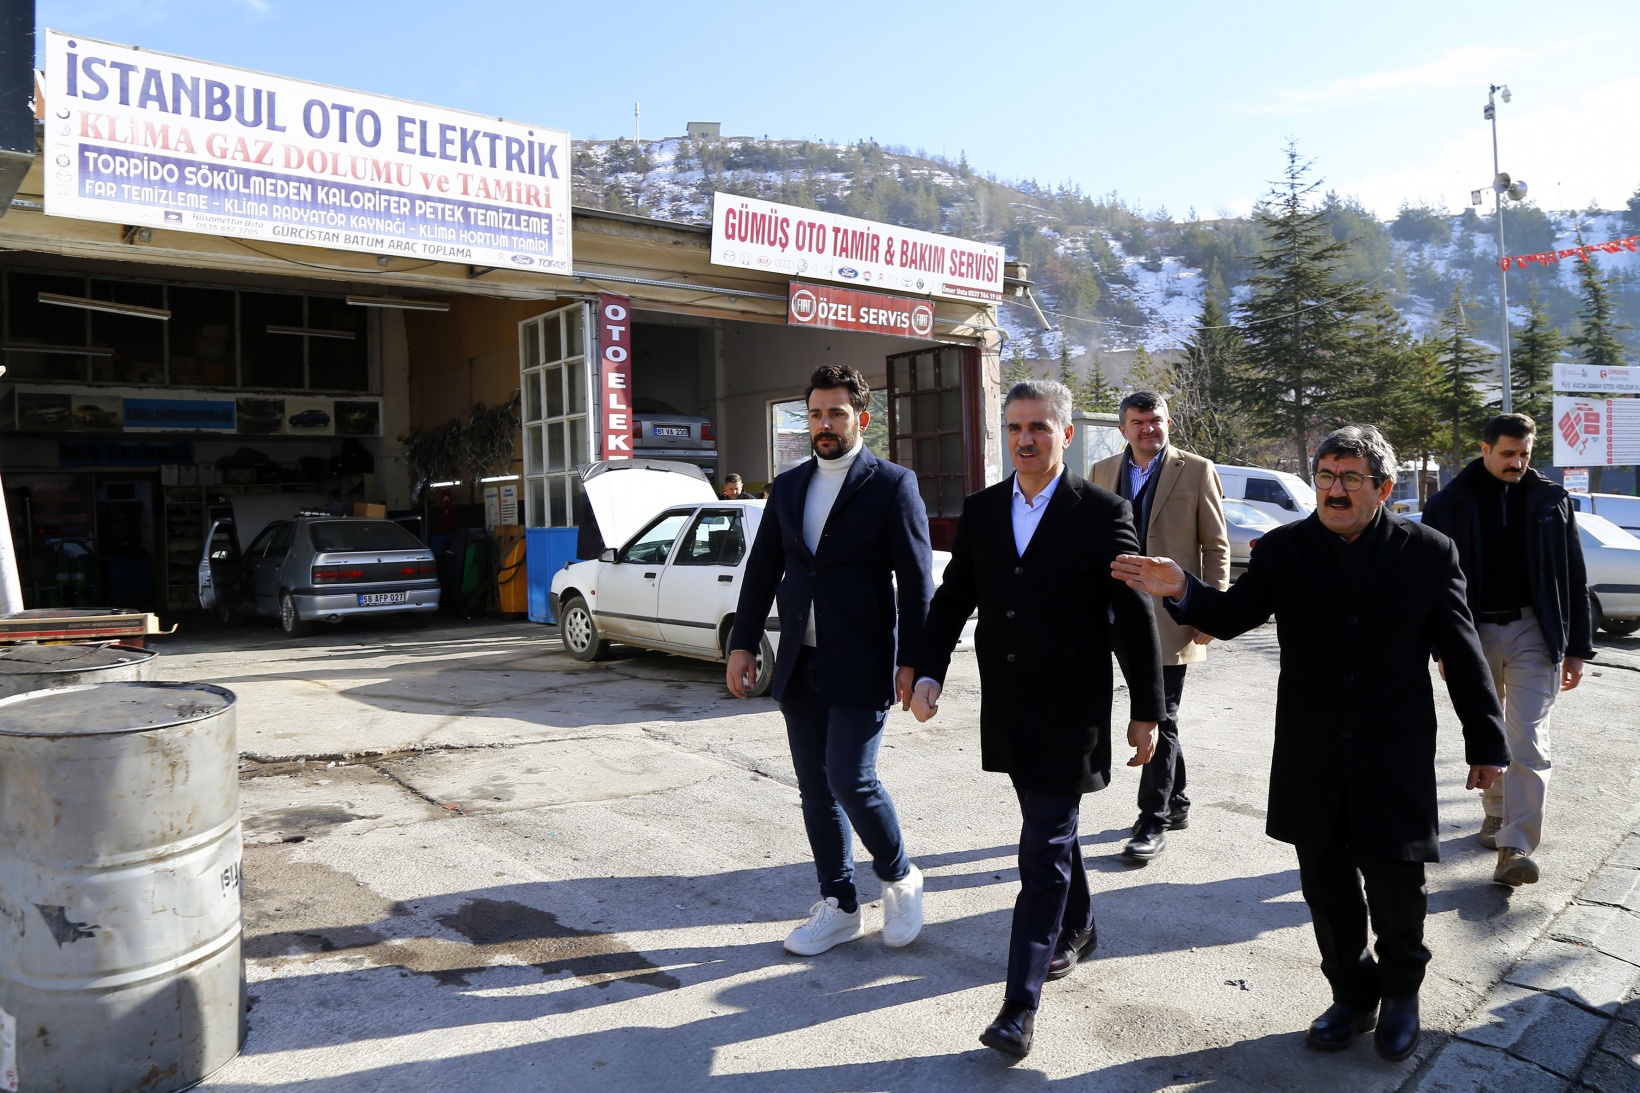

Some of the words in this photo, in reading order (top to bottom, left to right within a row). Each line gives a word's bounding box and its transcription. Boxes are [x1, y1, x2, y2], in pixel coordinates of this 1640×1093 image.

[66, 40, 287, 133] İSTANBUL
[303, 98, 382, 148] OTO
[397, 115, 560, 179] ELEKTRİK
[206, 132, 273, 167] GAZ
[282, 143, 413, 187] DOLUMU
[419, 171, 450, 193] ve
[84, 151, 179, 183] TORPİDO
[185, 165, 312, 203] SÖKÜLMEDEN
[317, 183, 410, 215] KALORİFER
[415, 200, 464, 222] PETEK
[467, 207, 550, 235] TEMİZLEME
[85, 180, 116, 198] FAR
[121, 184, 208, 210] TEMİZLEME
[225, 198, 268, 217] KLİMA
[272, 205, 346, 227] RADYATÖR
[350, 213, 406, 235] KAYNAĞI
[419, 223, 456, 240] KLİMA
[459, 230, 508, 248] HORTUM
[511, 236, 549, 253] TAMİRİ
[196, 222, 218, 231] 0535
[244, 219, 264, 228] Usta
[272, 224, 340, 243] GÜRCİSTAN
[344, 234, 384, 249] BATUM
[388, 239, 417, 254] ARAÇ
[422, 243, 472, 259] TOPLAMA
[724, 203, 790, 252] GÜMÜŞ
[795, 220, 826, 254] OTO
[833, 226, 880, 263] TAMİR
[884, 236, 895, 266] &
[900, 239, 946, 274] BAKIM
[949, 248, 999, 283] SERVİSİ
[604, 304, 628, 363] OTO
[797, 298, 812, 314] FIAT
[818, 297, 856, 322] ÖZEL
[916, 313, 929, 327] FIAT
[607, 372, 630, 461] ELEK
[666, 428, 674, 436] VA
[363, 595, 373, 603] 58
[374, 594, 388, 603] AFP
[389, 593, 403, 602] 027
